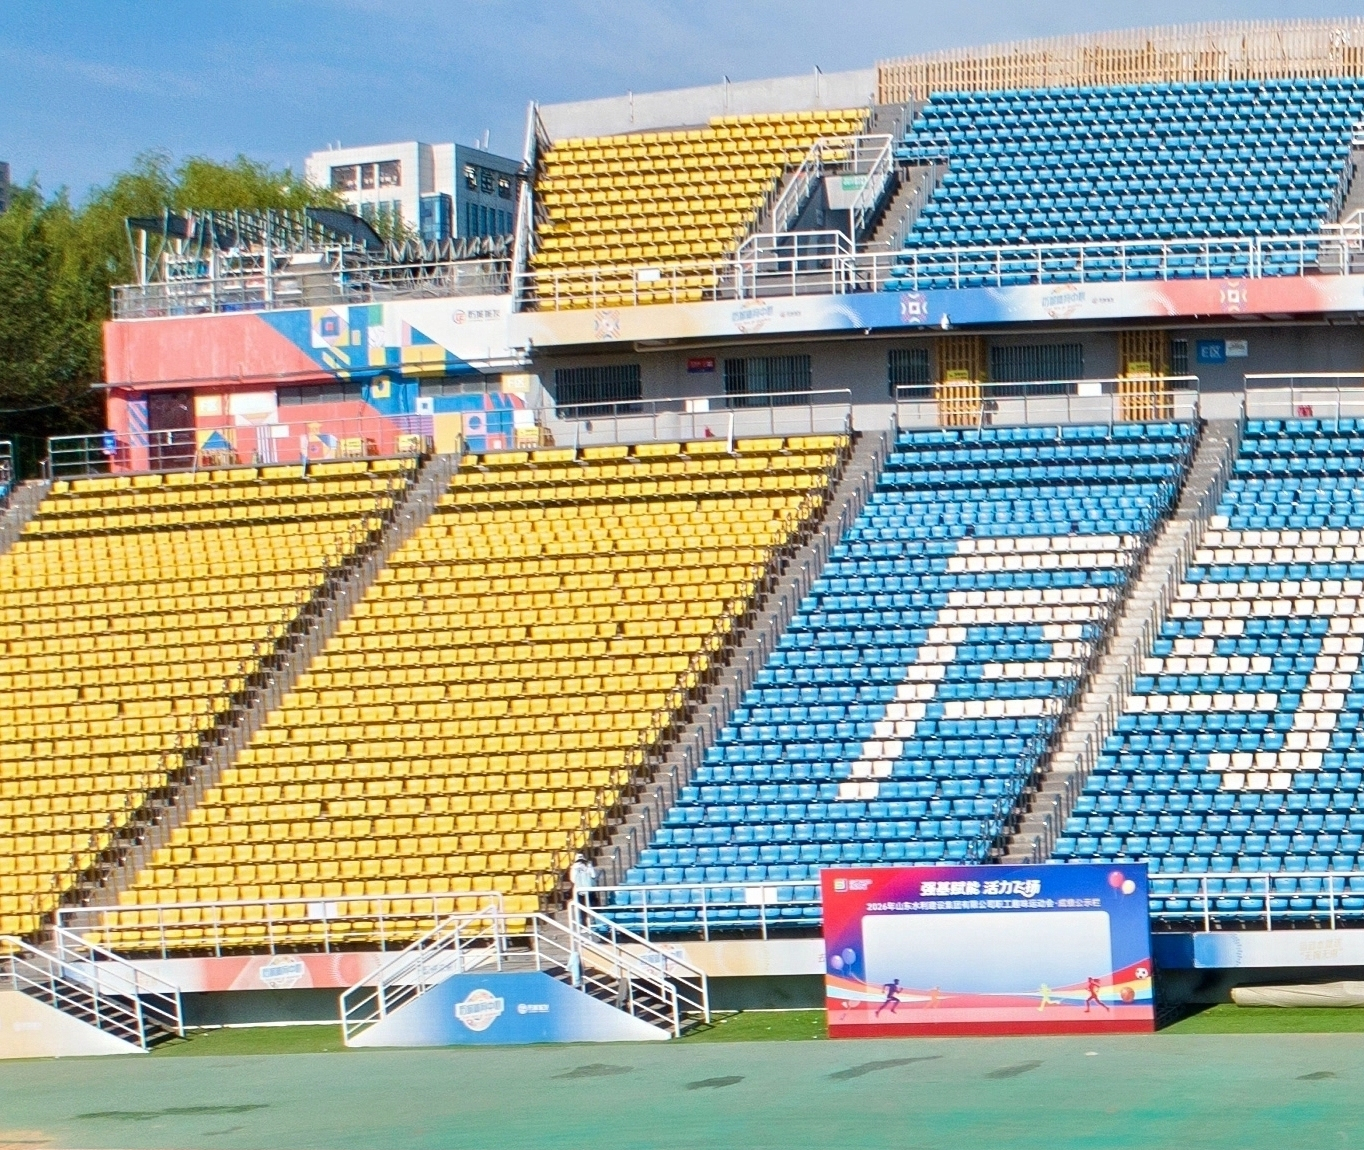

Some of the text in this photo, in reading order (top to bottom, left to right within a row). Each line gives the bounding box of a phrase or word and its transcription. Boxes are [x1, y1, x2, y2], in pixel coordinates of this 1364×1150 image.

[919, 879, 1042, 898] 强基赋能 活力飞扬
